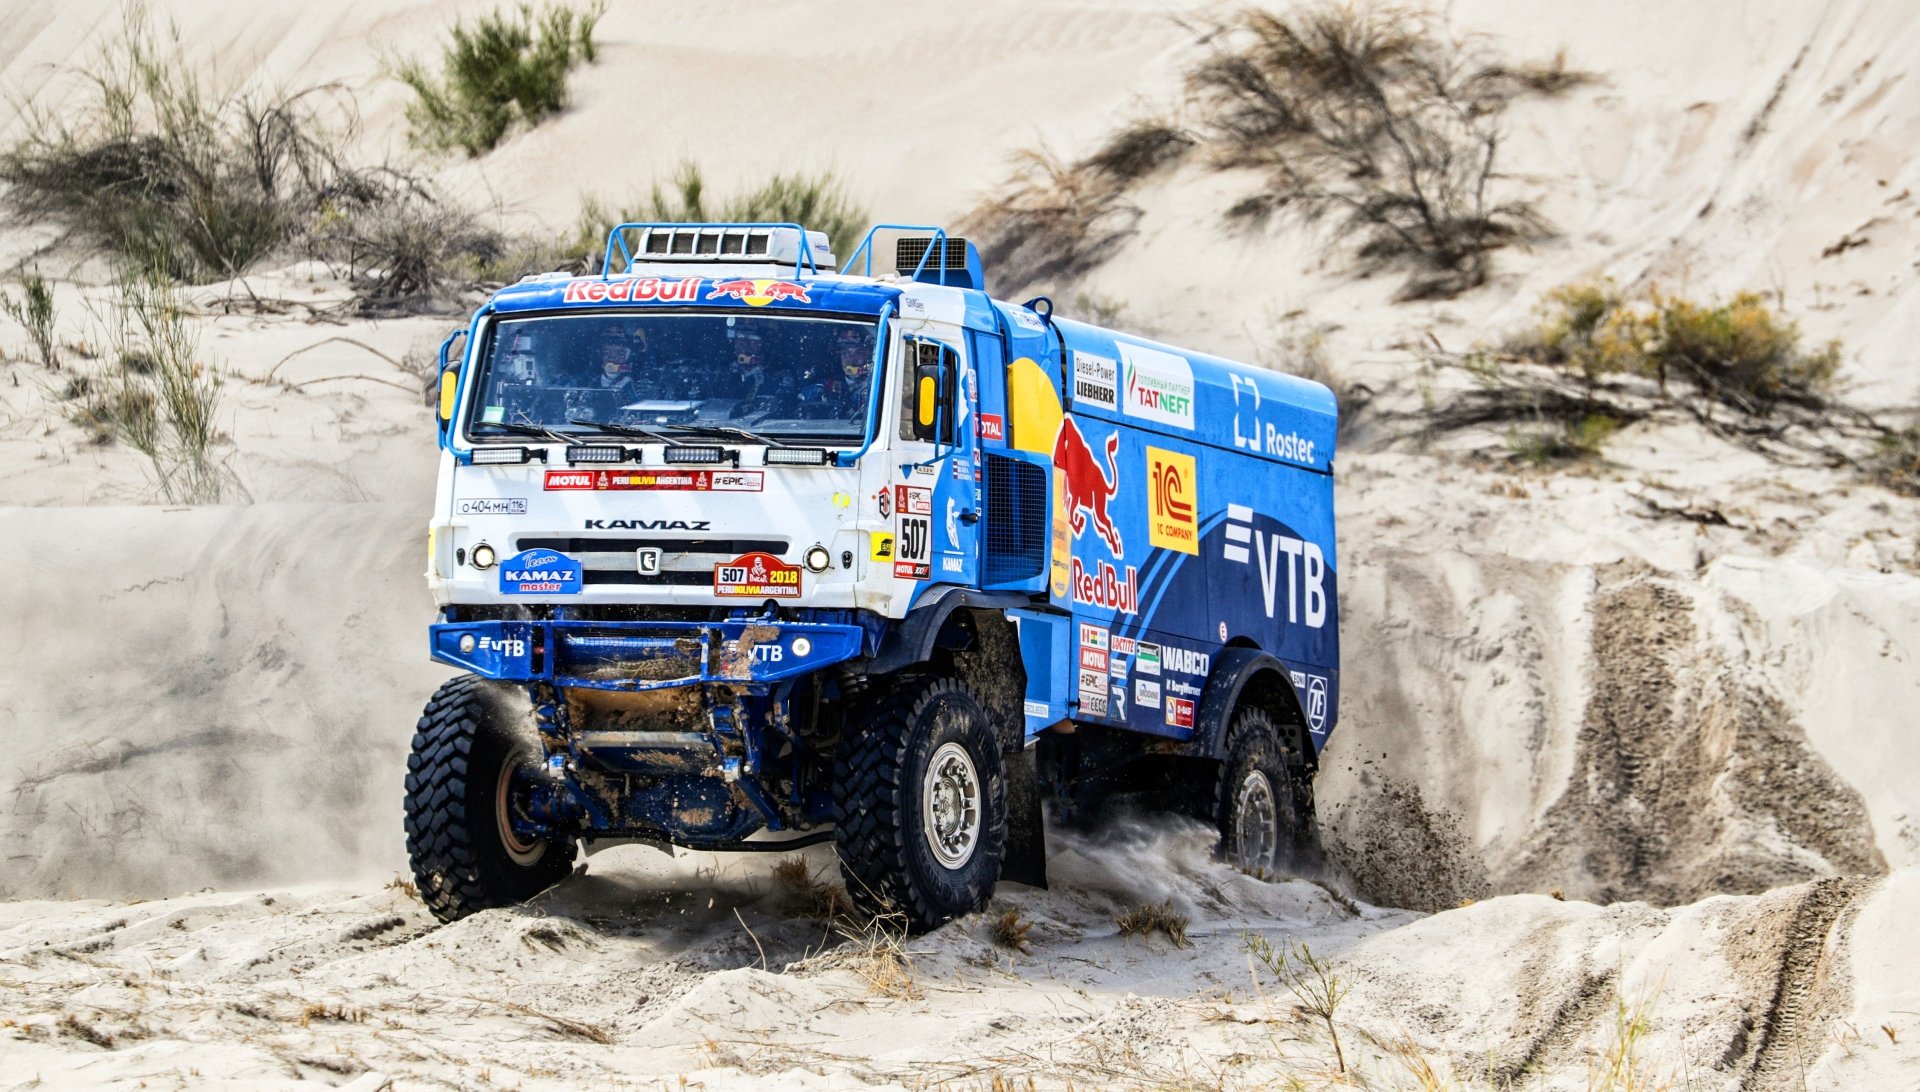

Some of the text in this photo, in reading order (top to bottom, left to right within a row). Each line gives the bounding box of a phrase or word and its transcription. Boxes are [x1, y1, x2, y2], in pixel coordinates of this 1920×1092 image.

[563, 278, 702, 303] Red Bull
[1076, 358, 1115, 381] Diesel-Power
[1076, 380, 1115, 404] LIEBHERR
[1138, 387, 1190, 416] TATNEFT
[975, 417, 1002, 436] TOTAL
[1266, 422, 1315, 464] Rostec
[548, 475, 591, 486] MOTUL
[1153, 461, 1192, 523] 1C
[585, 519, 711, 531] KAMAZ
[1165, 526, 1192, 542] COMPANY
[901, 518, 928, 560] 507
[522, 552, 558, 569] Team
[896, 564, 914, 575] MOTUL
[943, 557, 963, 573] KAMAZ
[505, 570, 574, 581] KAMAZ
[722, 568, 744, 582] 507
[769, 570, 798, 584] 2018
[1255, 530, 1326, 629] VTB
[520, 582, 561, 591] master
[760, 586, 799, 595] ARGENTINA
[1072, 556, 1138, 615] Red Bull
[491, 640, 525, 657] VTB
[1112, 636, 1135, 654] LOCTITE
[1082, 650, 1106, 669] MOTUL
[1162, 645, 1210, 677] WABCO
